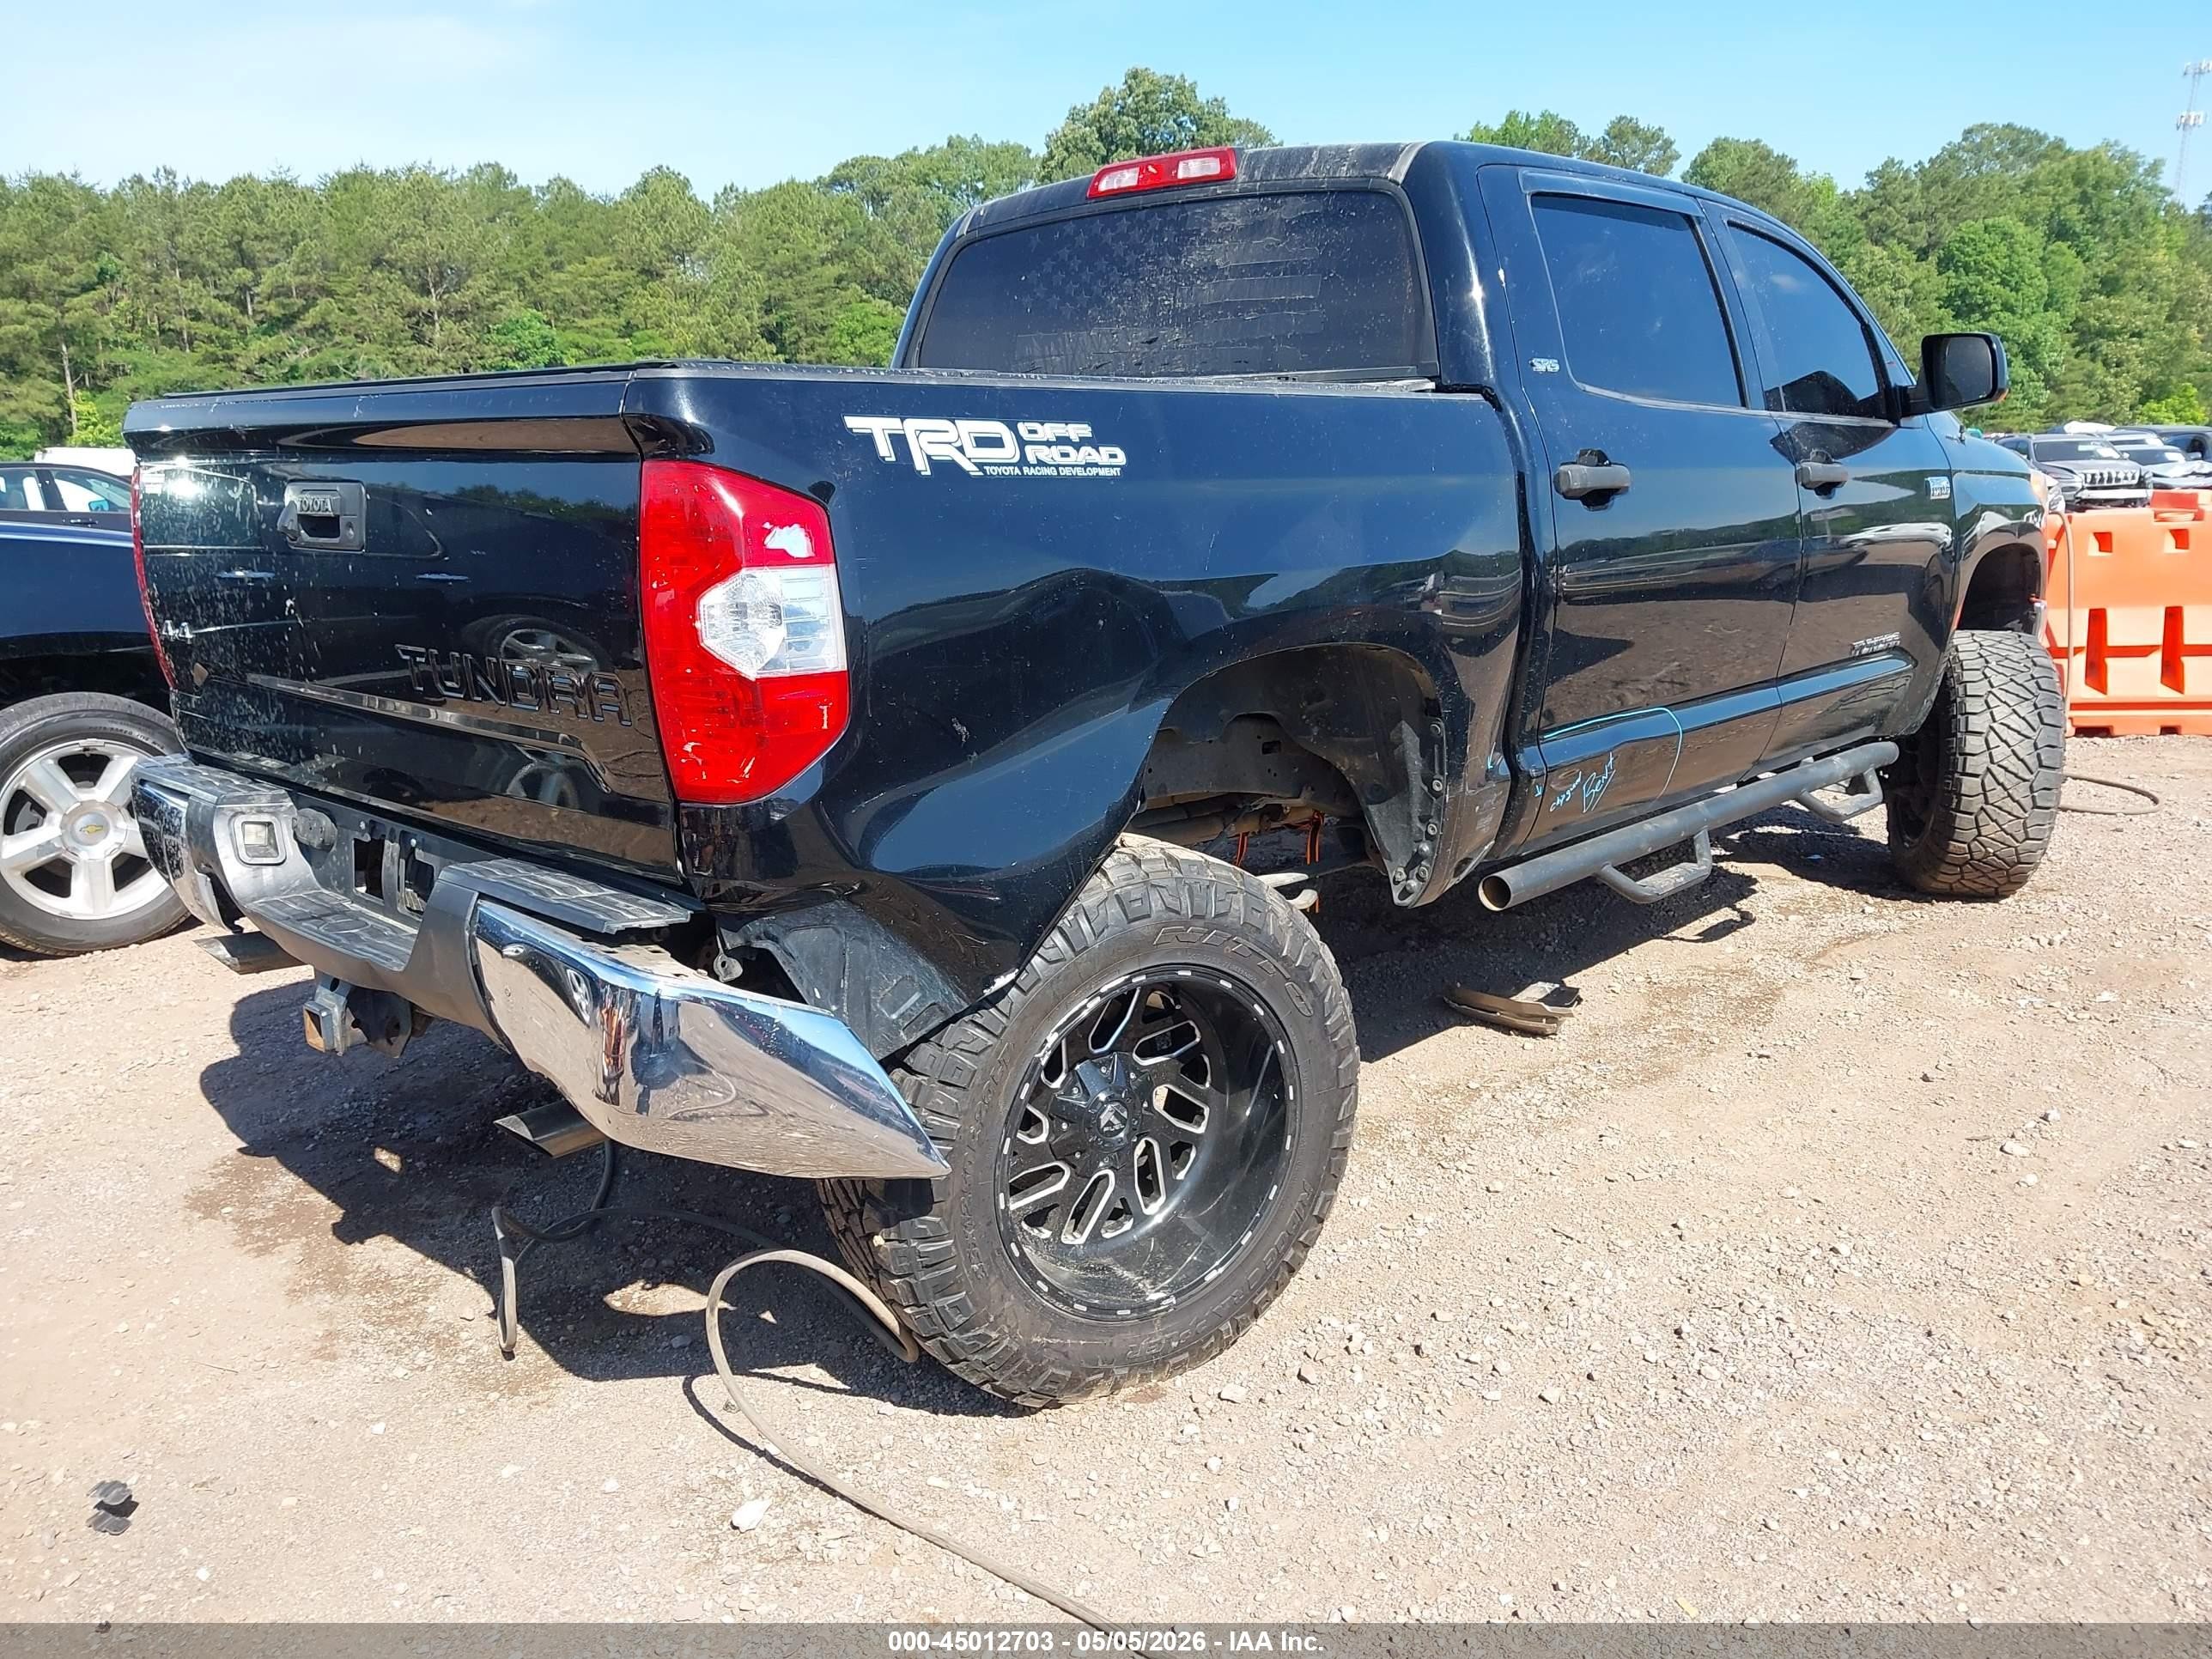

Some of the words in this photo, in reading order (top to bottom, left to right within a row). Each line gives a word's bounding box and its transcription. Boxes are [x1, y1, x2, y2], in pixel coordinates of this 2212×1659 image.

[1017, 422, 1093, 442] OFF
[844, 416, 1020, 476] TRD
[1024, 445, 1127, 465] ROAD
[983, 465, 1022, 476] TOYOTA
[1023, 466, 1057, 476] RACING
[1058, 466, 1121, 477] DEVELOPMENT
[297, 496, 332, 513] TOYOTA
[394, 644, 632, 726] TUNDRA
